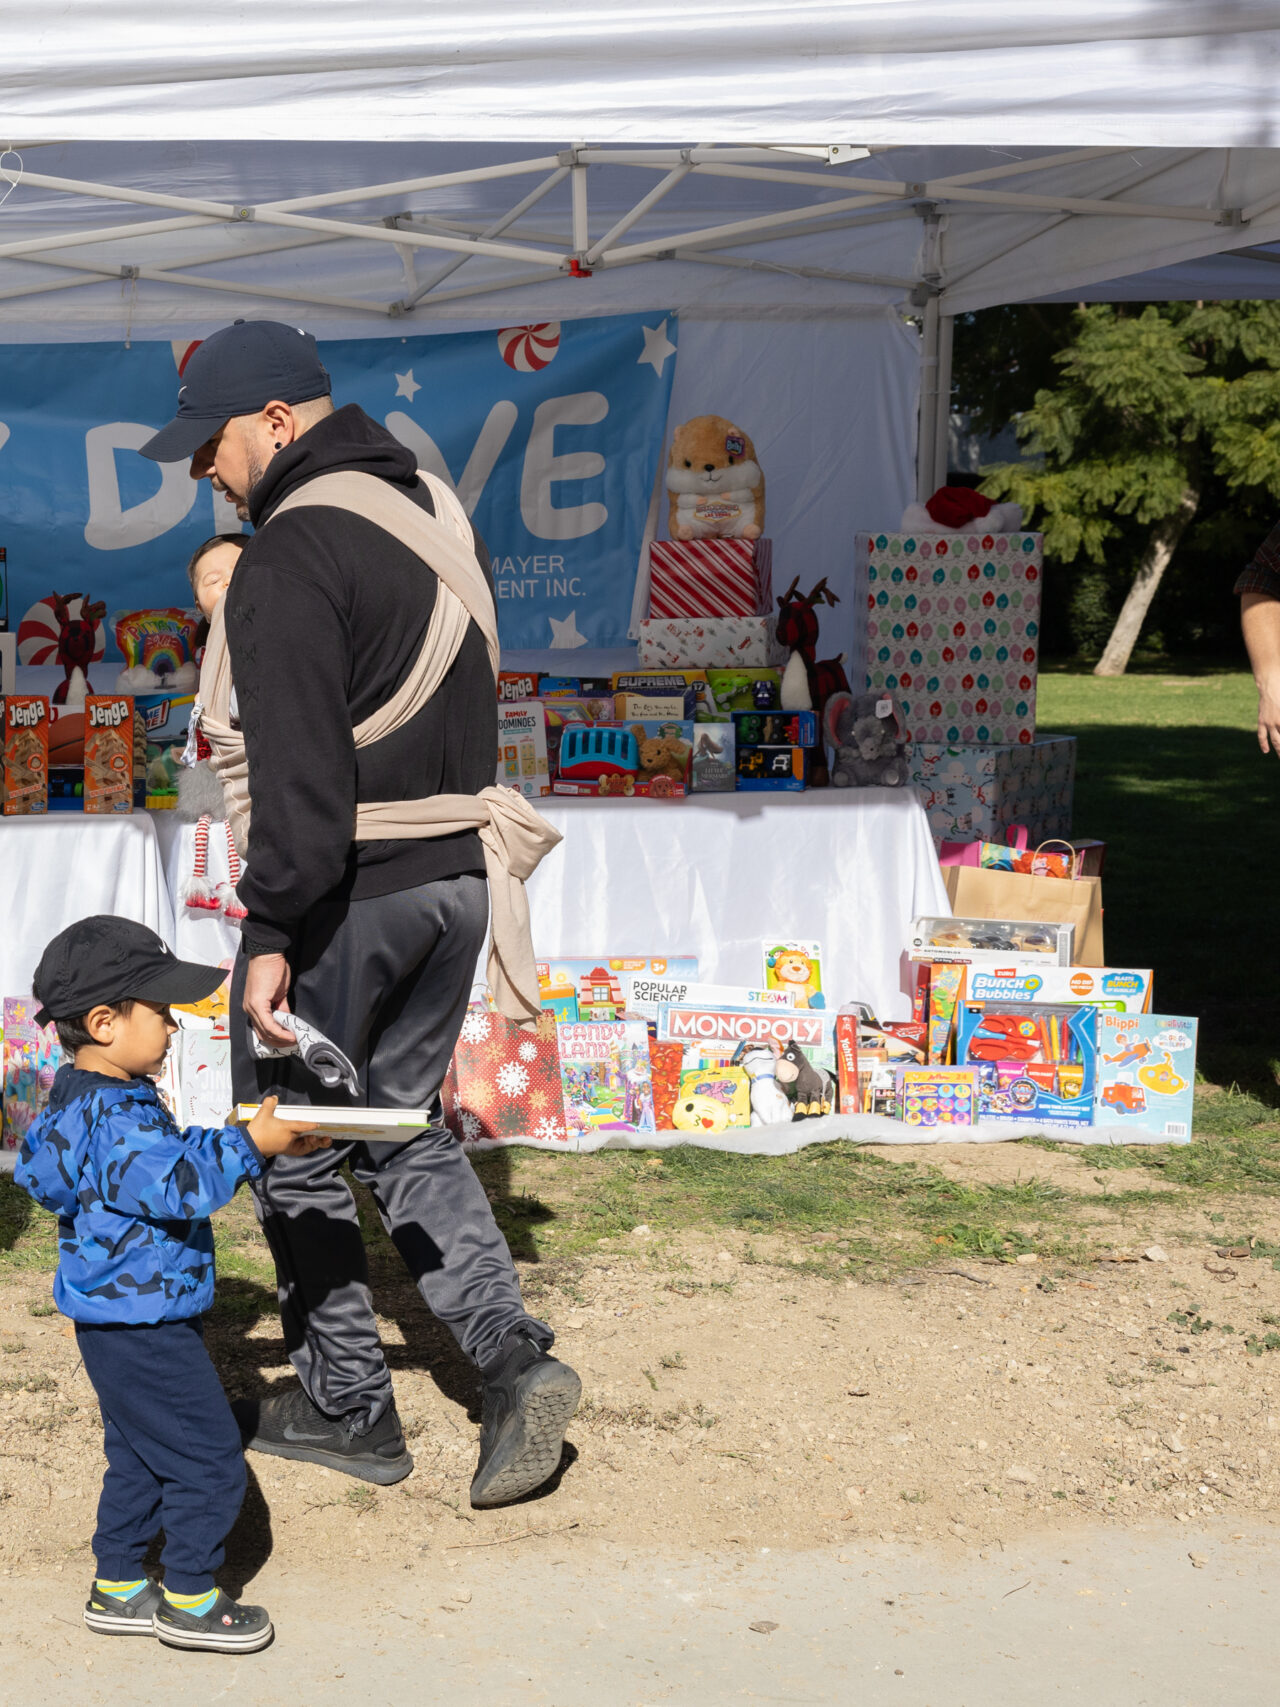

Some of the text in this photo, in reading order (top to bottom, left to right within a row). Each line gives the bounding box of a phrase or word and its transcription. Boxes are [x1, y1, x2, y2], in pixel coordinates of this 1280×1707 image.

[546, 577, 587, 597] INC.
[498, 677, 534, 701] Jenga
[617, 675, 686, 687] SUPREME
[8, 700, 45, 727] Jenga
[89, 700, 129, 727] Jenga
[505, 710, 528, 718] FAMILY
[498, 716, 536, 730] DOMINOES
[652, 961, 666, 972] 3+
[632, 980, 687, 995] POPULAR
[1106, 980, 1139, 988] BUNCH
[634, 990, 686, 1002] SCIENCE
[559, 1023, 626, 1040] CANDY
[673, 1013, 822, 1043] MONOPOLY
[1105, 1015, 1139, 1032] Blippi
[560, 1041, 611, 1059] LAND
[840, 1037, 855, 1072] Yahtzee
